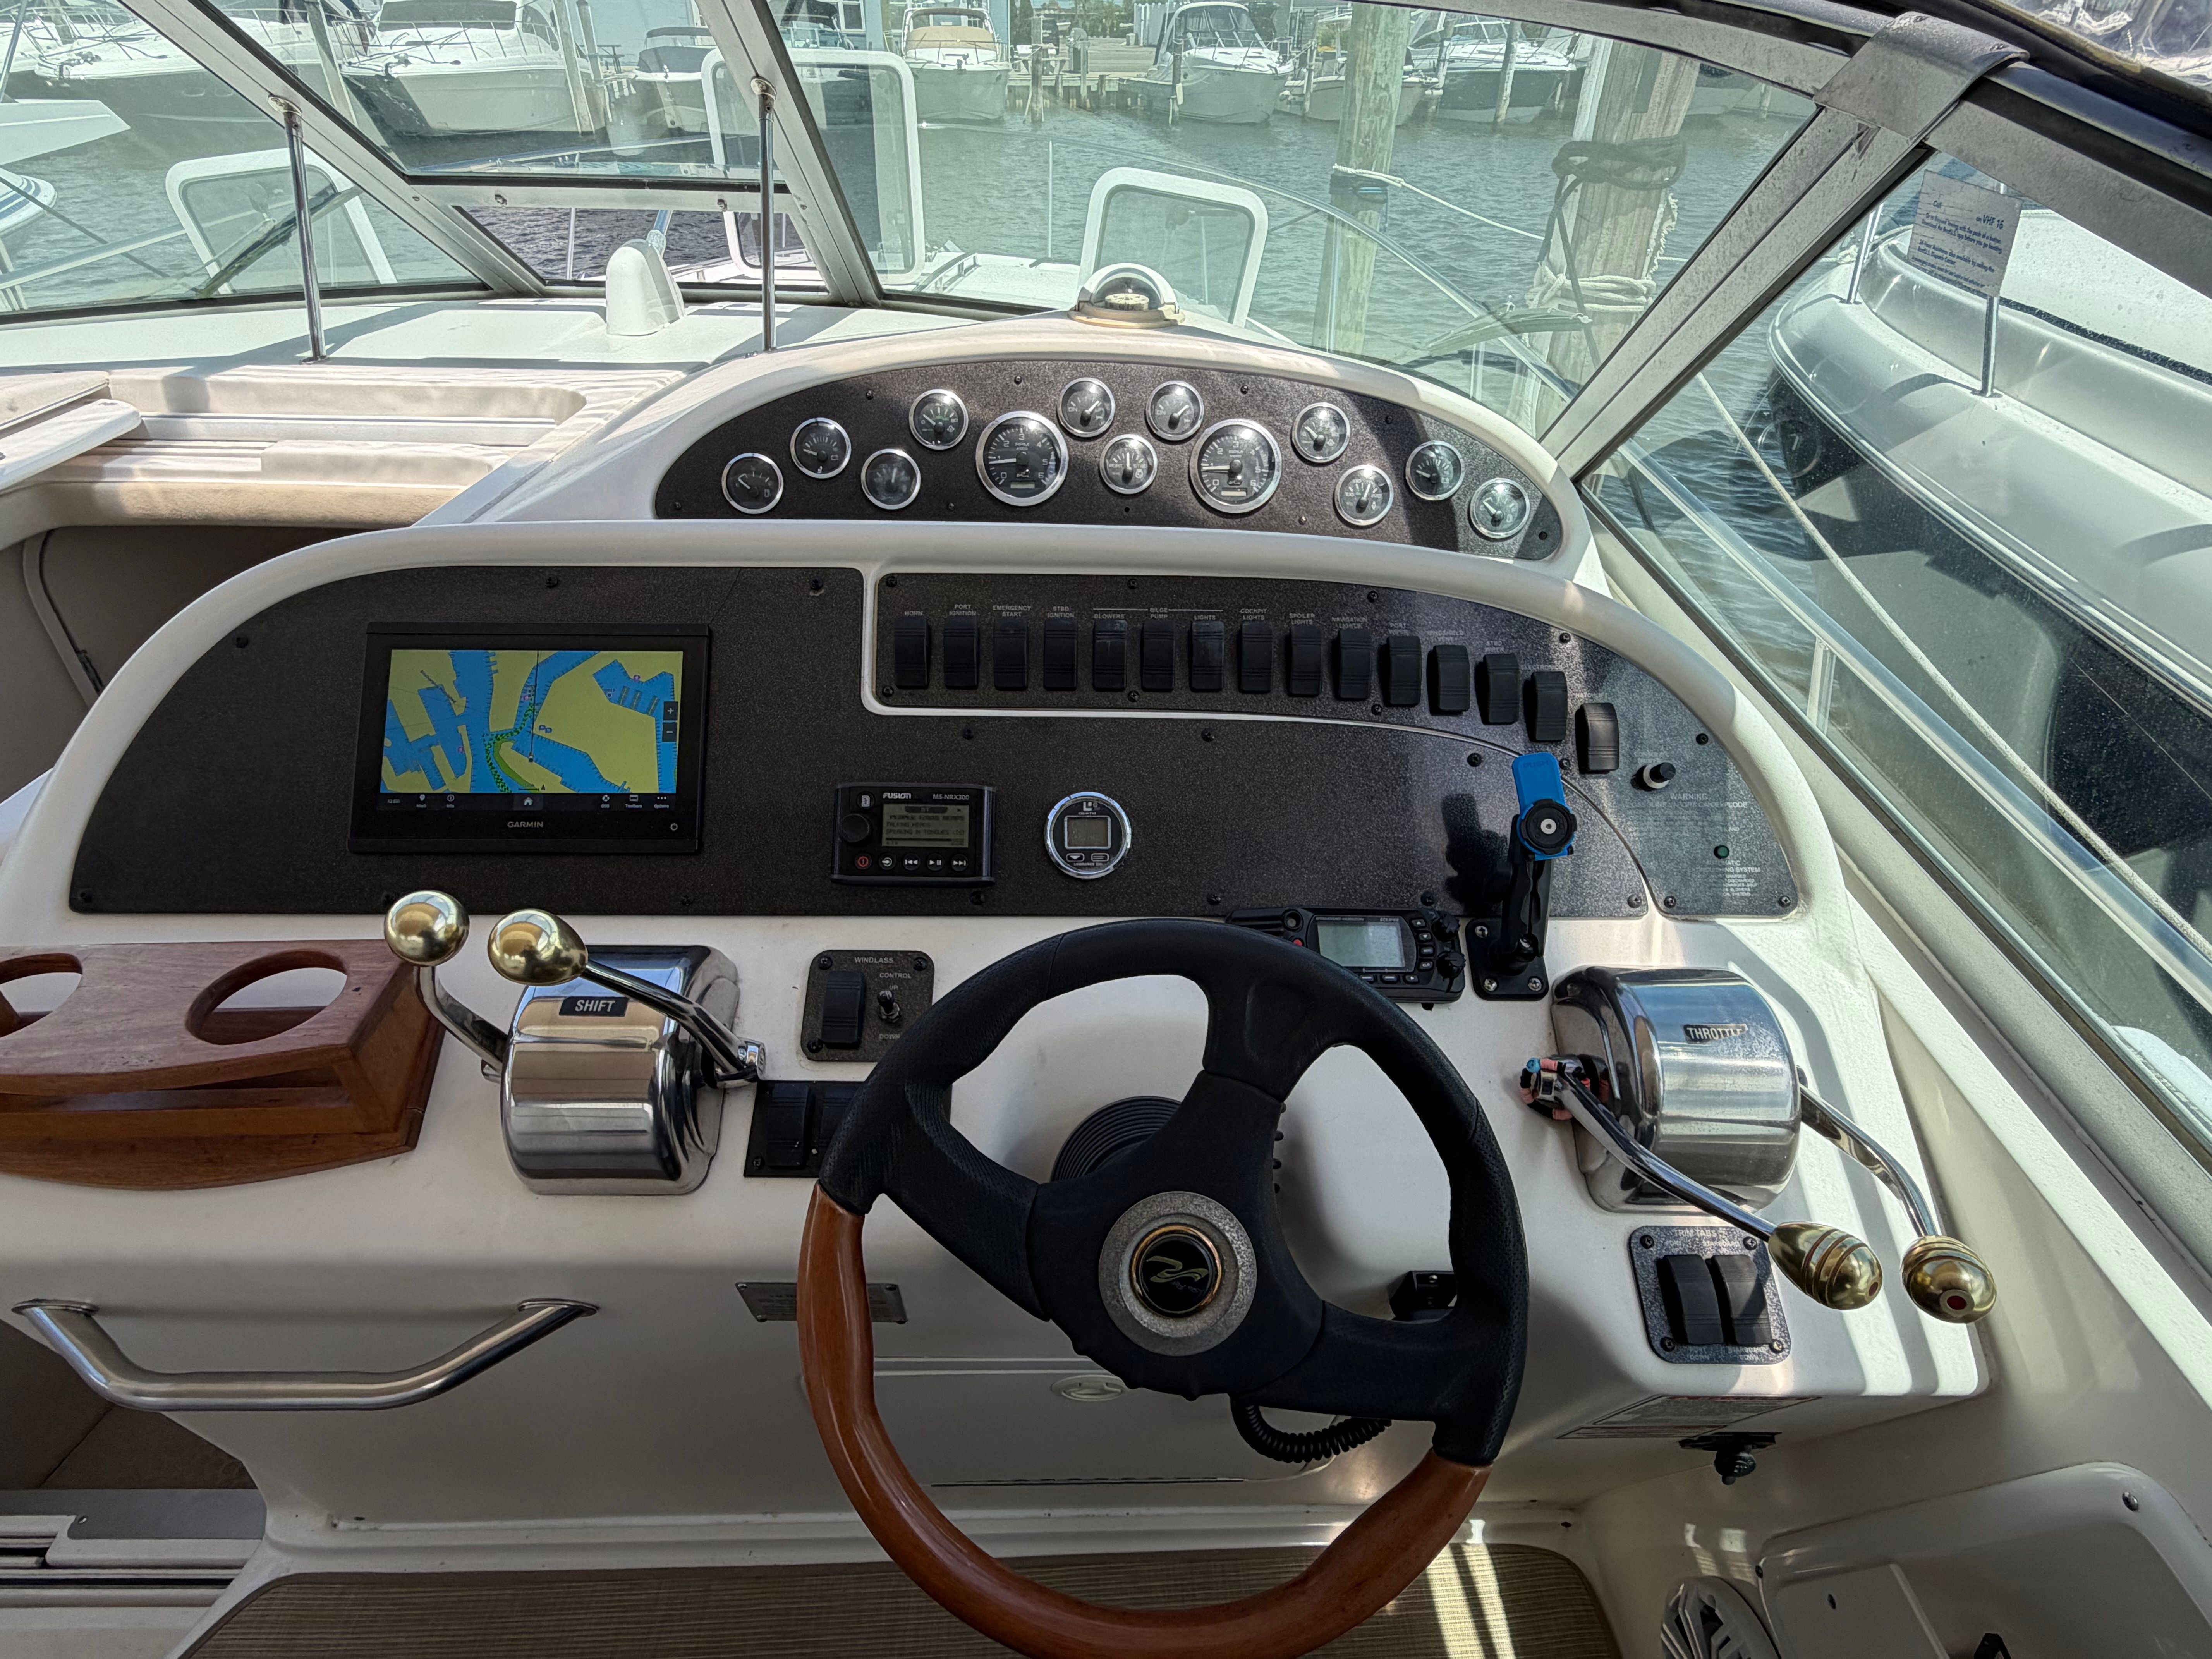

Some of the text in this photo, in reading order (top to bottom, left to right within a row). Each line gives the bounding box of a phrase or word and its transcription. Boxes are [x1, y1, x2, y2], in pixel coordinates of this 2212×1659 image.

[1982, 215, 1996, 225] VHF
[1997, 219, 2004, 229] 16
[1670, 793, 1708, 801] WARNING
[575, 1000, 616, 1012] SHIFT
[1674, 1229, 1717, 1237] TRIM TABS
